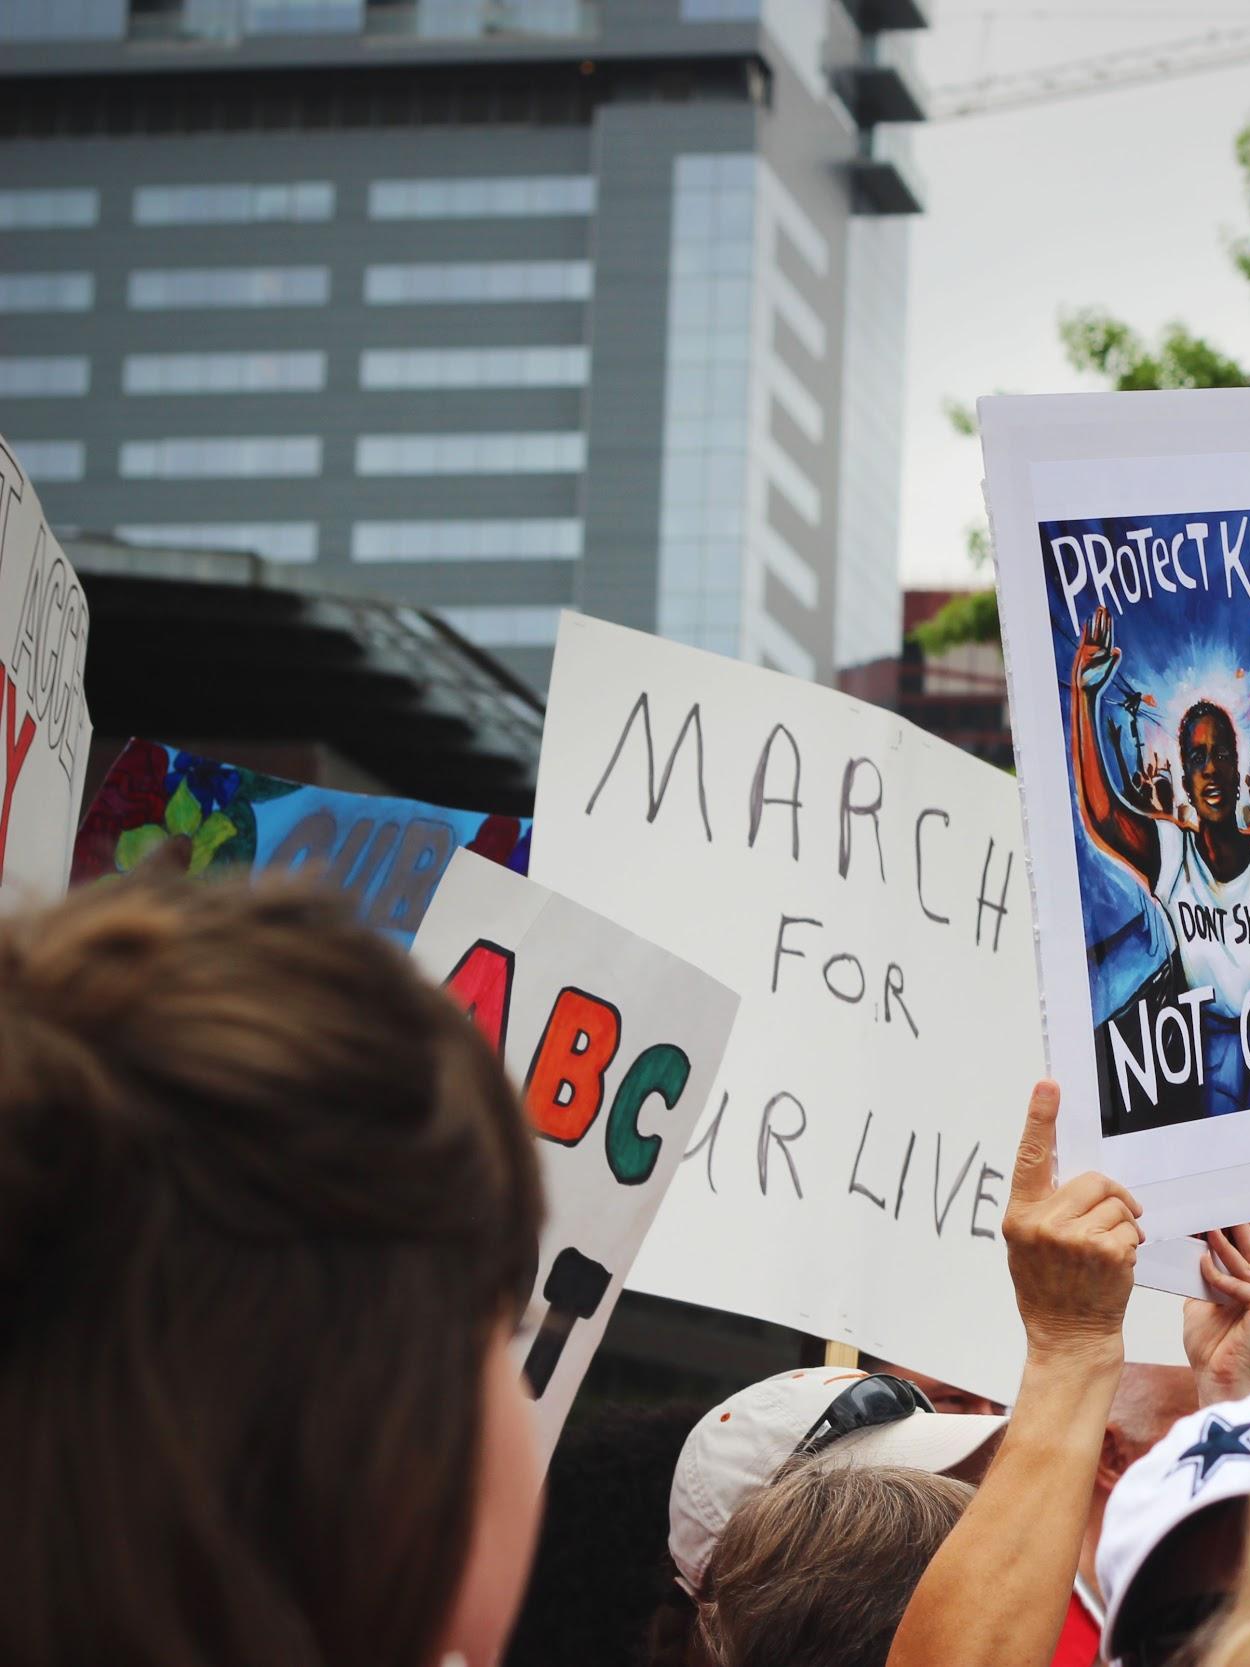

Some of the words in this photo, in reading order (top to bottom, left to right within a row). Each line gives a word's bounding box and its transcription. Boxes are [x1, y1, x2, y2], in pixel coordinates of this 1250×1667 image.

[585, 691, 1013, 953] MARCH
[771, 913, 919, 1039] FOR
[1178, 901, 1227, 945] DONT
[1107, 984, 1214, 1115] NOT
